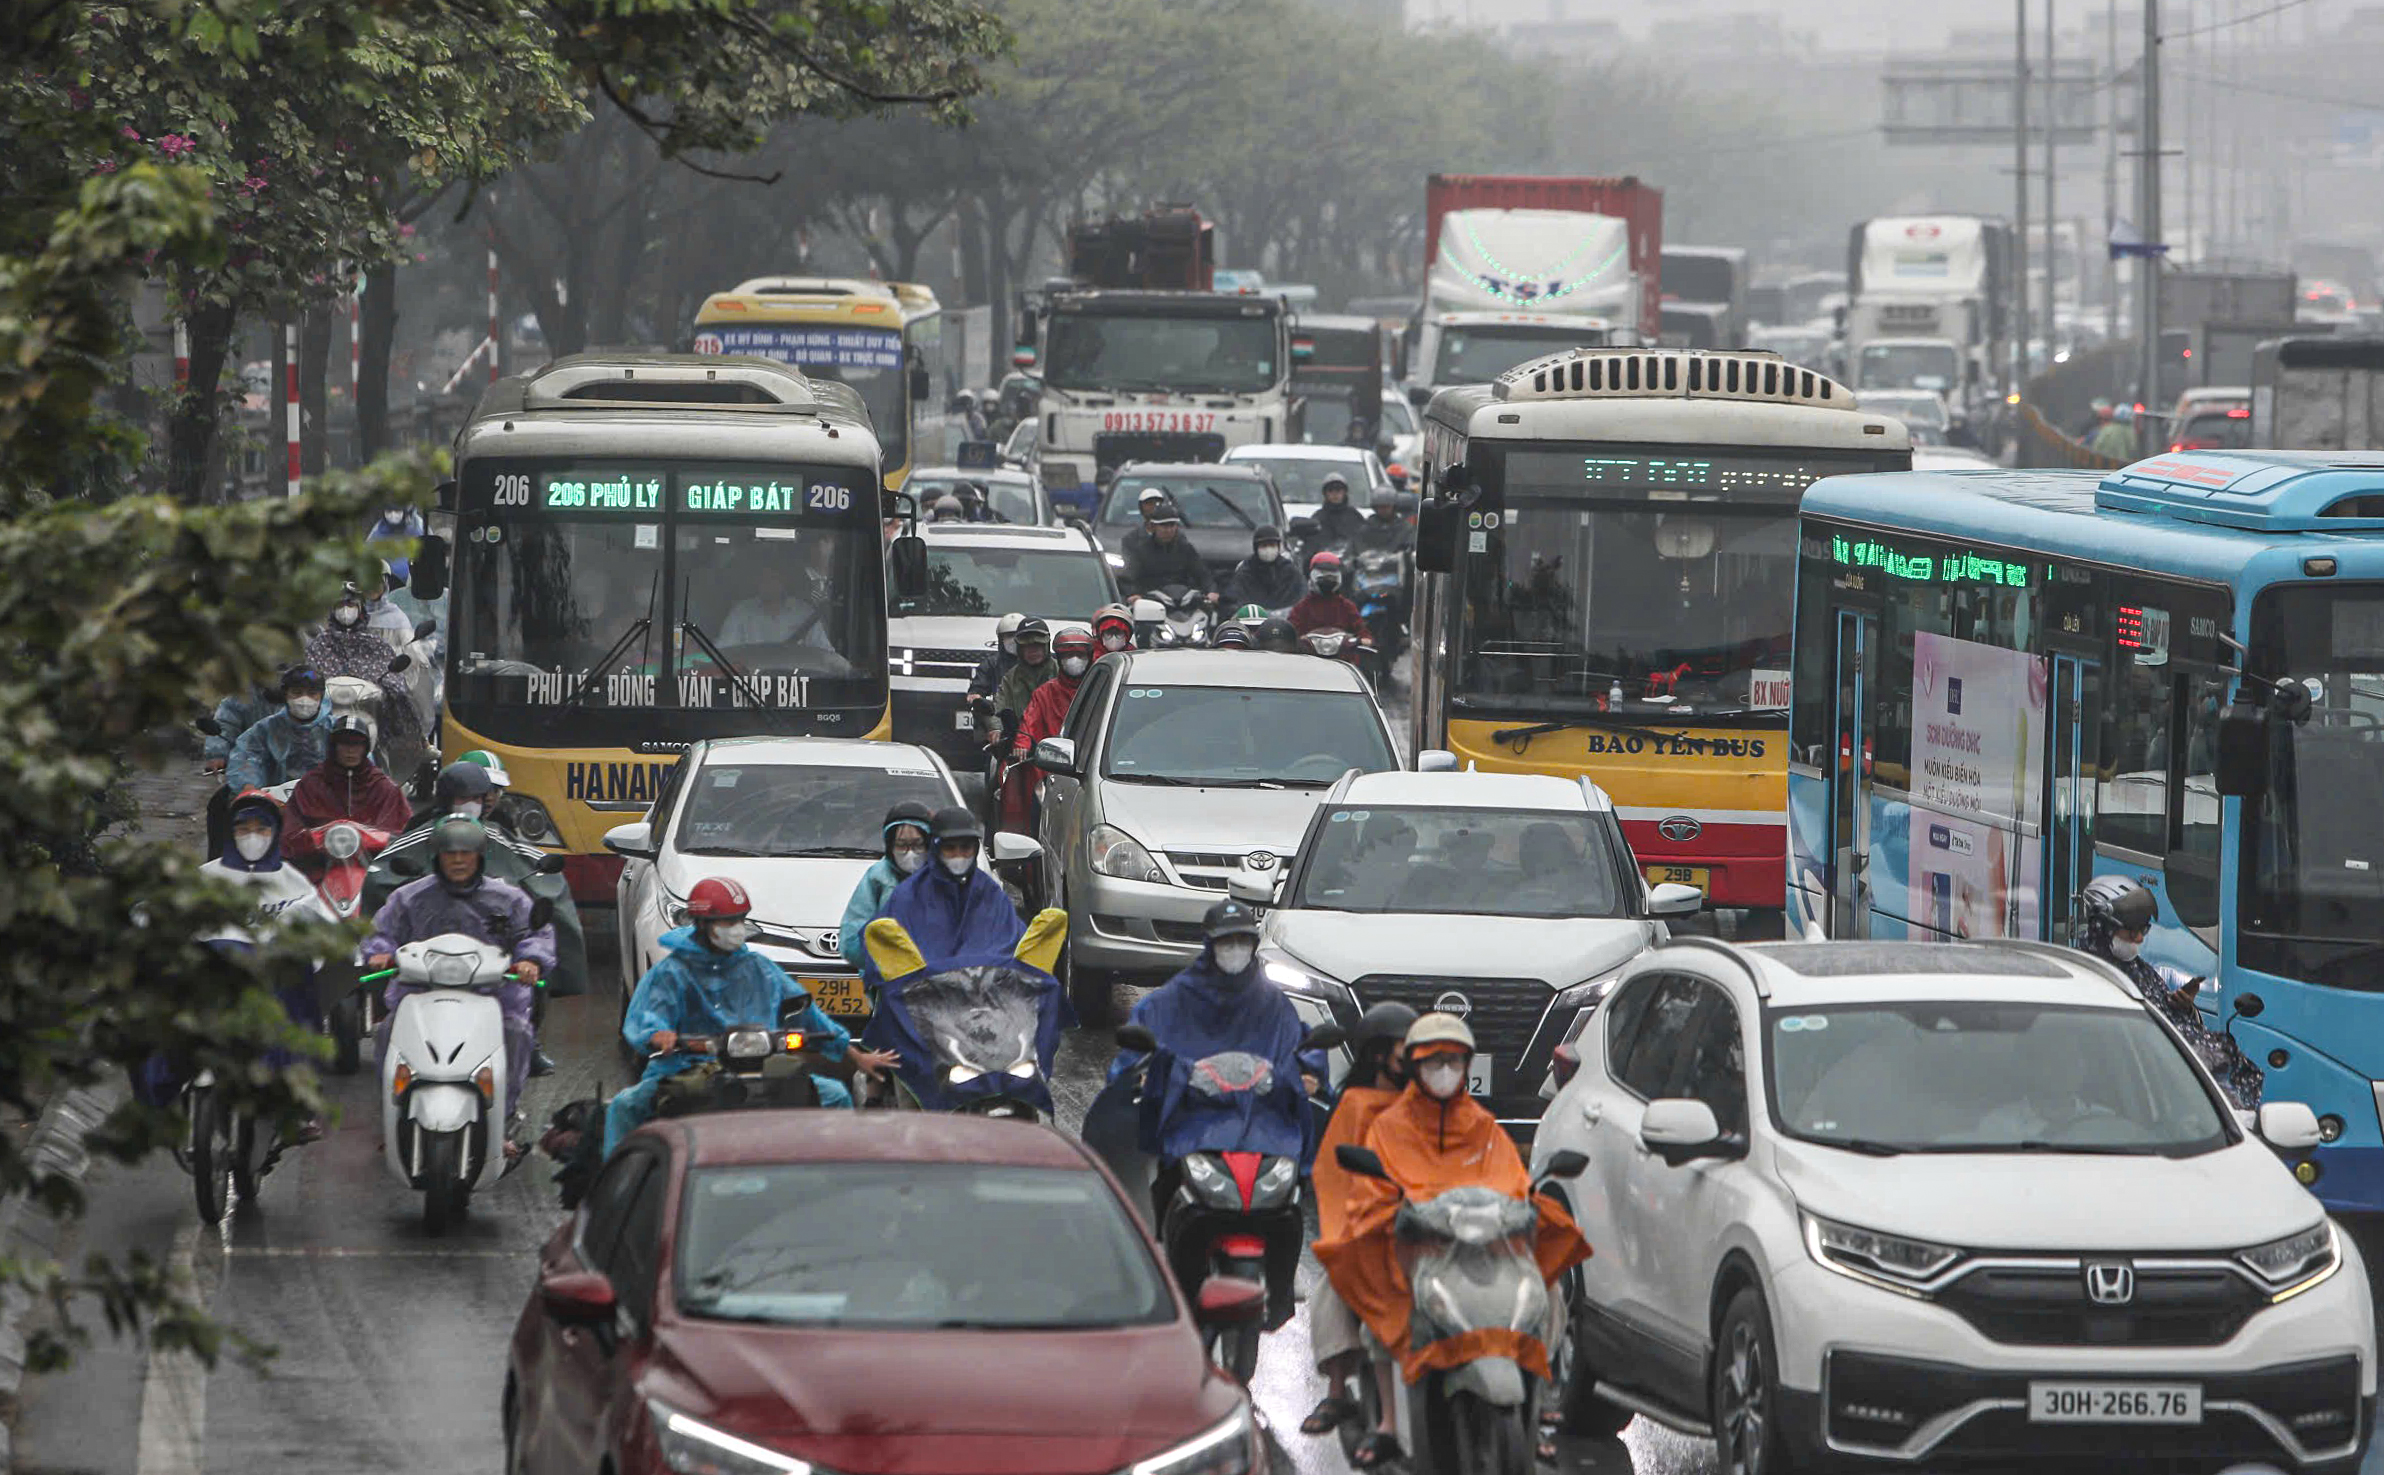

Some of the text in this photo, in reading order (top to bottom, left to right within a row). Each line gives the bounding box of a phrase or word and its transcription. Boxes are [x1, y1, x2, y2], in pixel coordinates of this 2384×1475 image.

[494, 475, 530, 505] 206
[548, 475, 660, 508] 206 PHỦ LÝ
[688, 480, 794, 510] GIÁP BÁT
[810, 485, 850, 510] 206
[2190, 616, 2215, 637] SAMCO
[527, 665, 562, 704] PHỦ
[608, 665, 655, 706] ĐỒNG
[678, 669, 713, 708] VĂN
[732, 669, 772, 708] GIÁP
[777, 668, 809, 708] BÁT
[1754, 680, 1767, 705] BX
[642, 742, 691, 752] SAMCO
[1712, 738, 1765, 758] BUS
[567, 762, 675, 800] HANAM
[694, 822, 732, 832] TAXI
[1664, 868, 1692, 881] 29B
[818, 980, 850, 995] 29H
[1434, 1004, 1472, 1012] NISSAN
[2045, 1391, 2187, 1416] 30H-266.76
